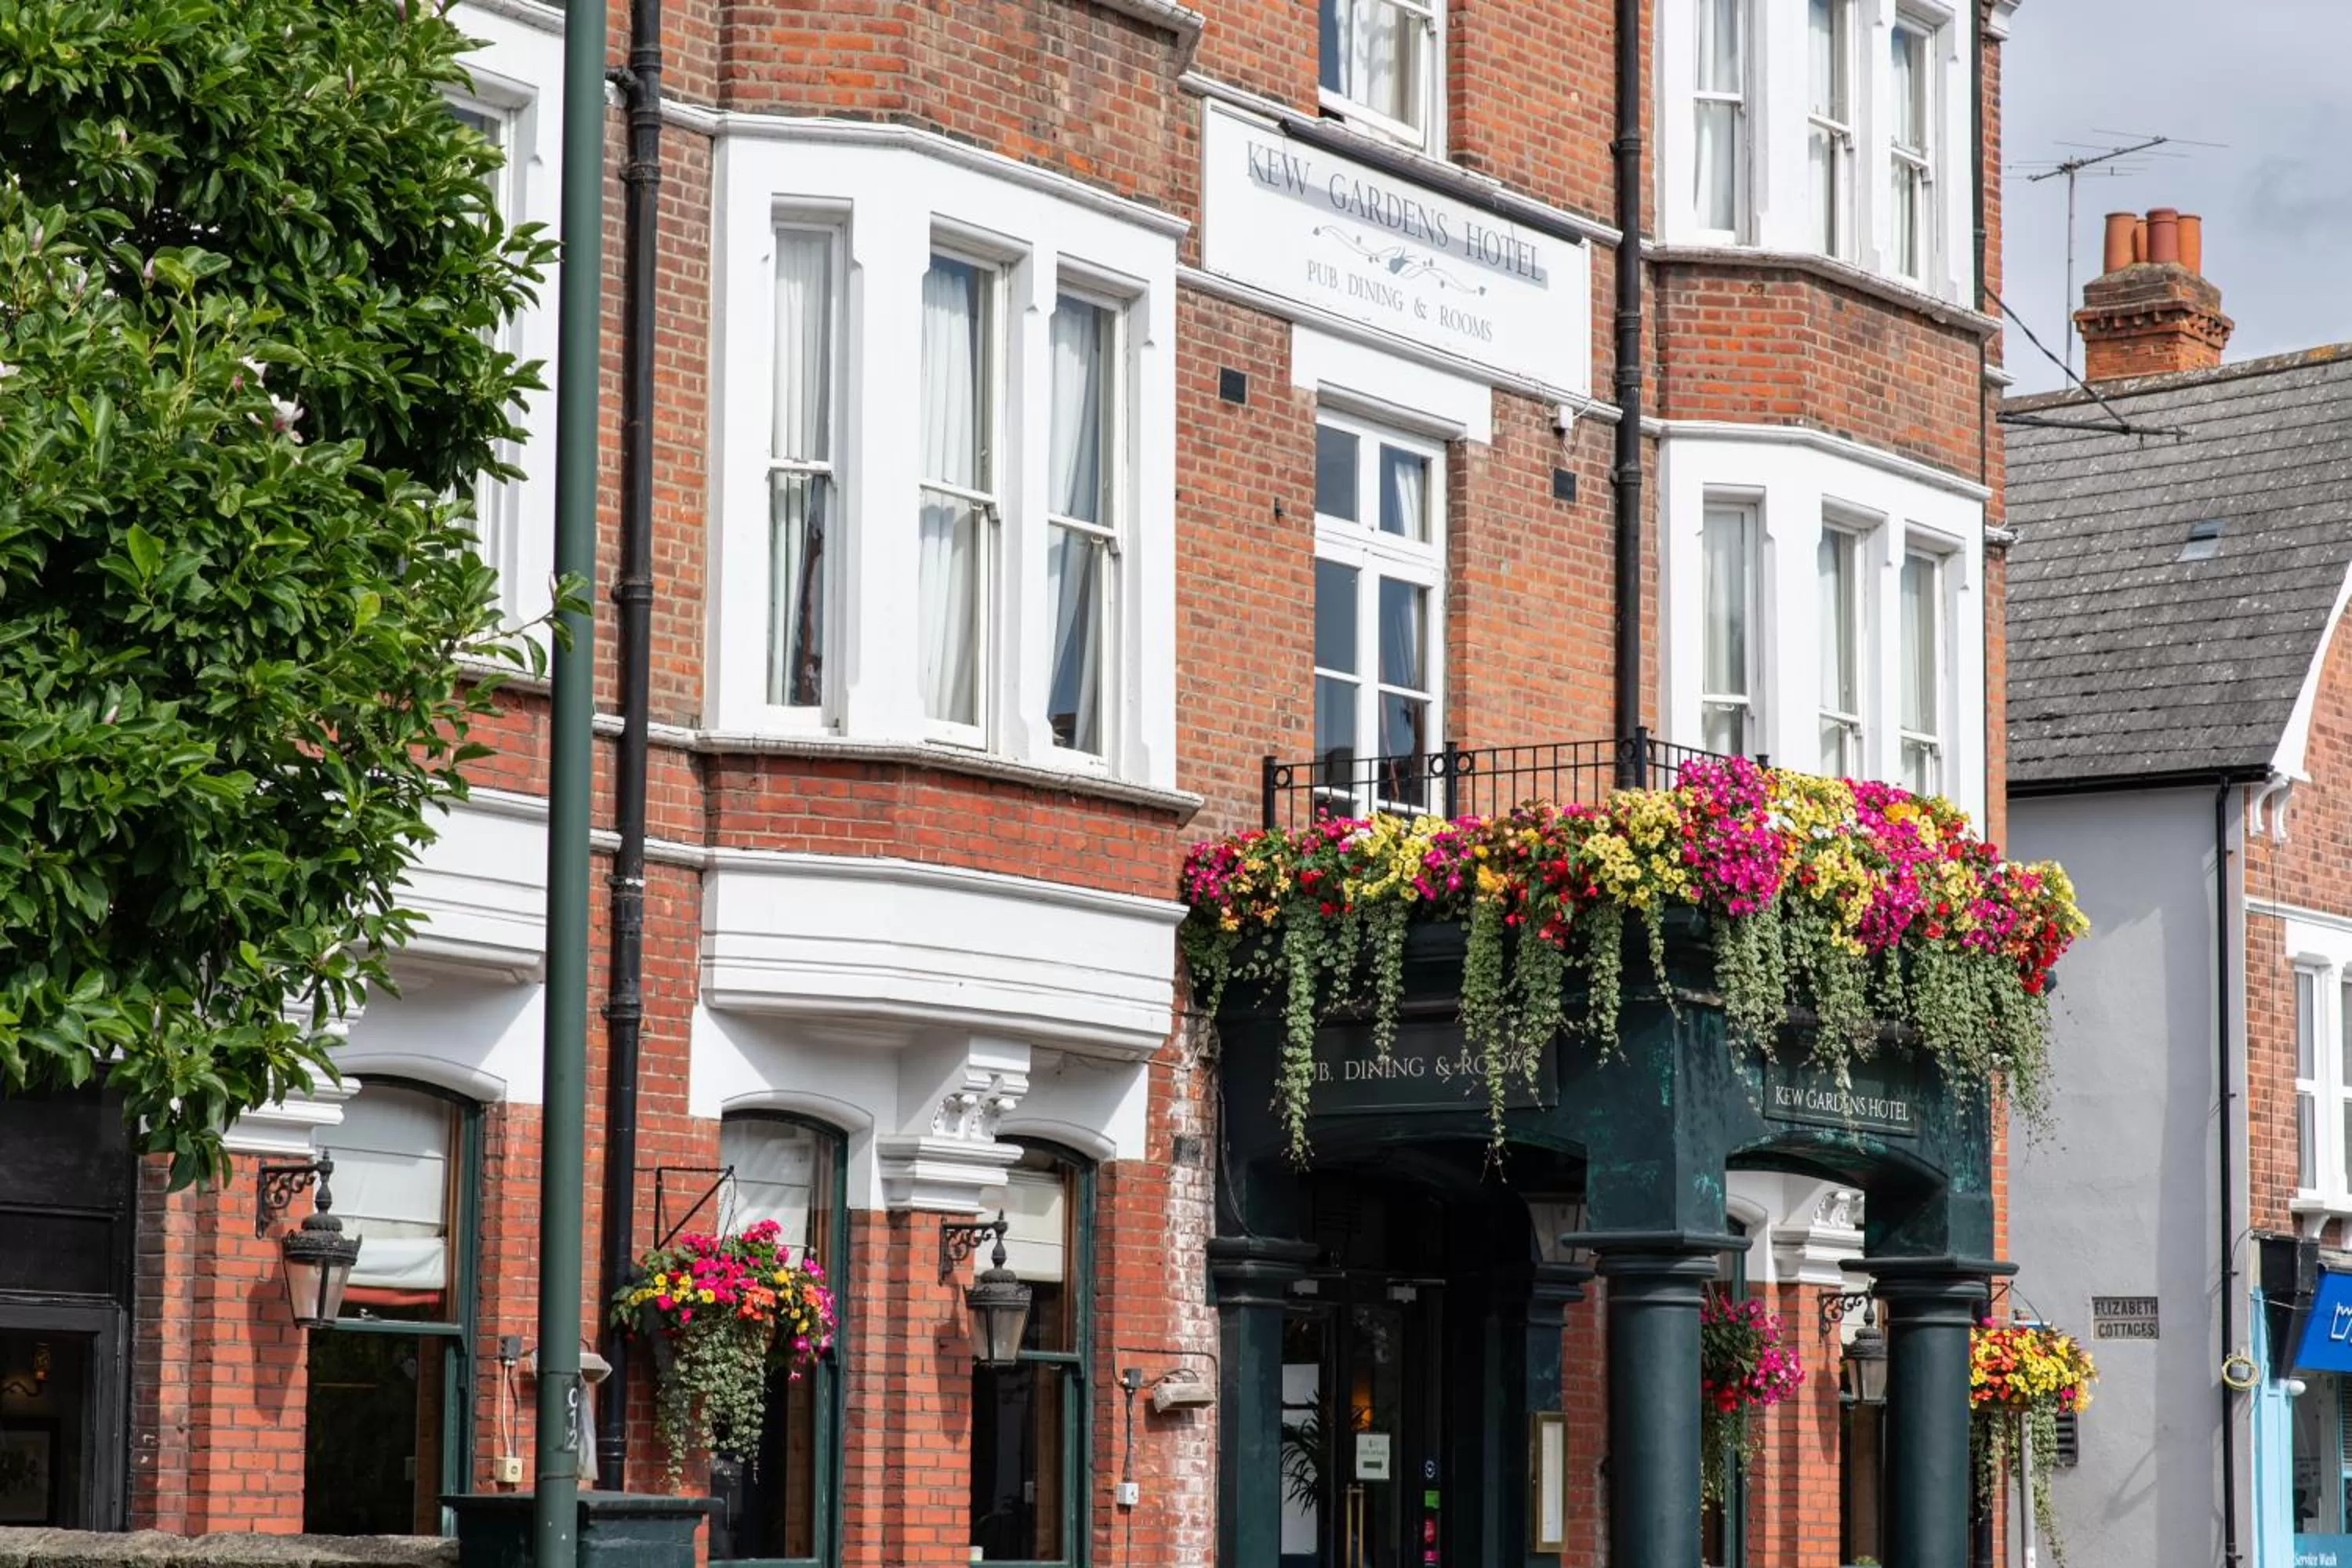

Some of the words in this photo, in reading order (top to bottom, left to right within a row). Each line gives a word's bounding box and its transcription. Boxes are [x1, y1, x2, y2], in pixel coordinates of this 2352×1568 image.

[1247, 141, 1311, 197] KEW
[1329, 173, 1449, 247] GARDENS
[1465, 222, 1544, 281] HOTEL
[1348, 274, 1404, 312] DINING
[1414, 299, 1428, 319] &
[1440, 305, 1493, 342] ROOMS
[1344, 1056, 1425, 1080] DINING
[1436, 1054, 1450, 1076] &
[1460, 1053, 1537, 1075] ROOM
[1775, 1086, 1804, 1105] KEW
[1869, 1098, 1910, 1121] HOTEL
[2094, 1299, 2158, 1316] ELIZABETH
[2098, 1323, 2156, 1338] COTTAGES
